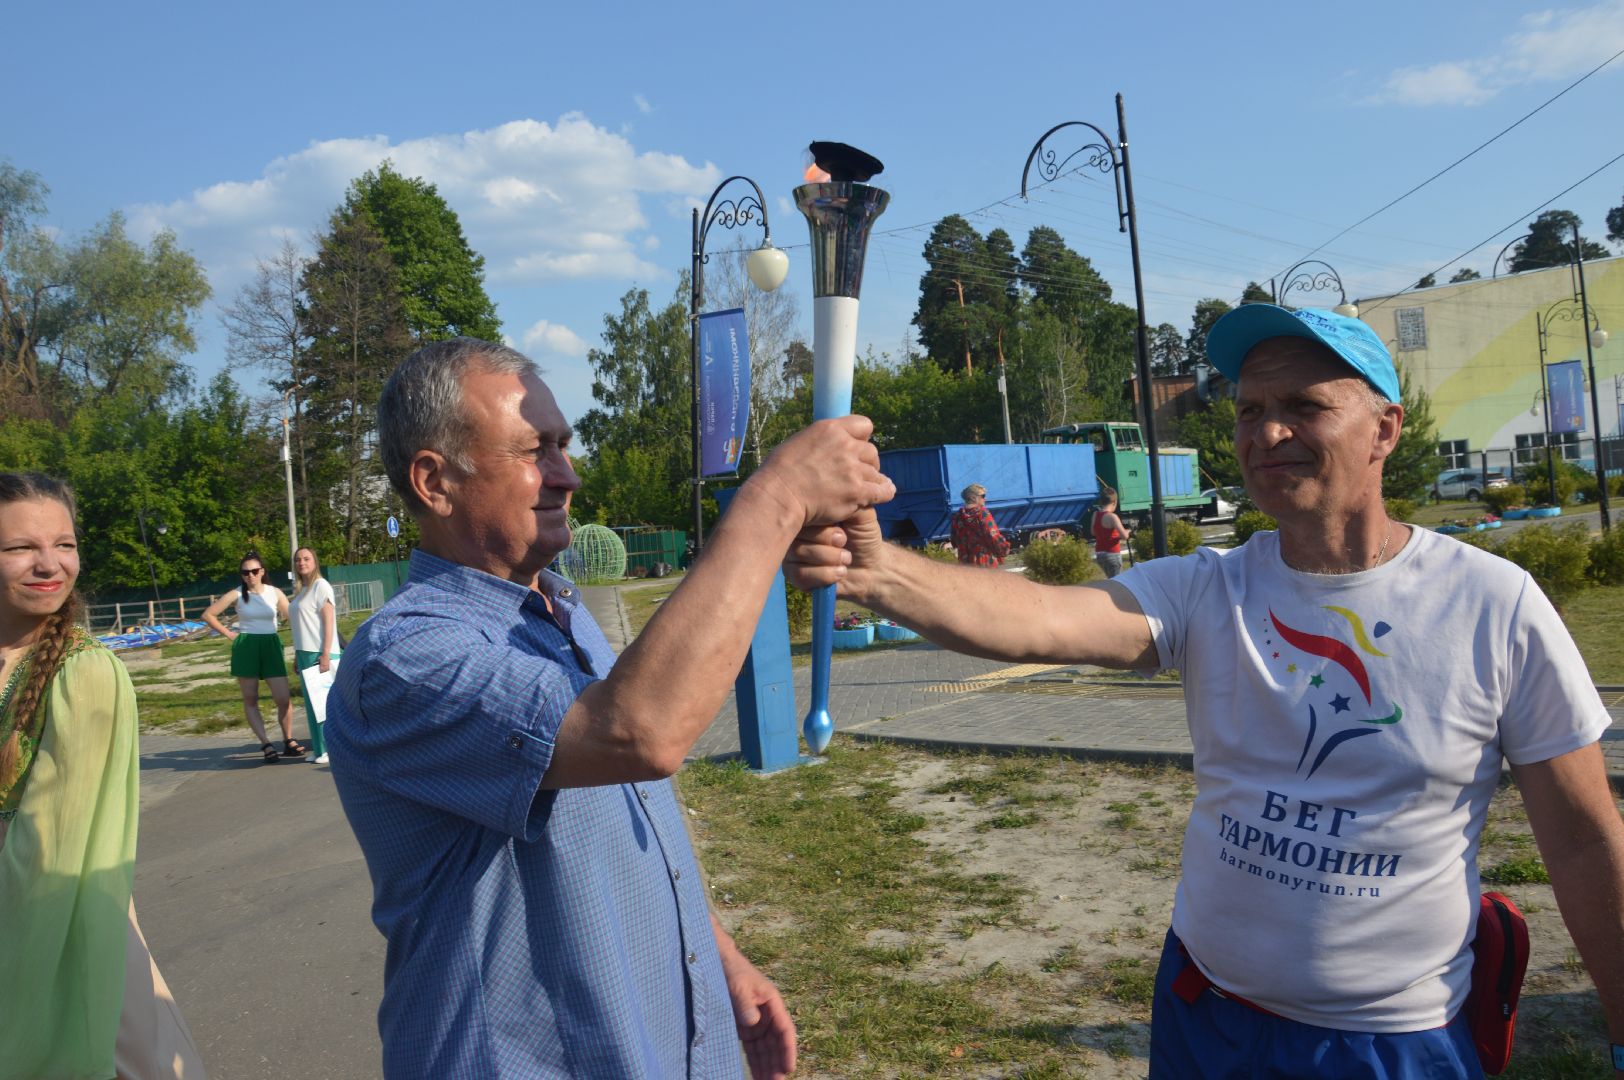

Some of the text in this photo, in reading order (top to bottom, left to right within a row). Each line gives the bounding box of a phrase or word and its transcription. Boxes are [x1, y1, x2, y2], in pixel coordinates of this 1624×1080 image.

[1260, 789, 1358, 838] БЕГ
[1218, 813, 1402, 877] ГАРМОНИИ
[1219, 847, 1381, 898] harmonyrun.ru
